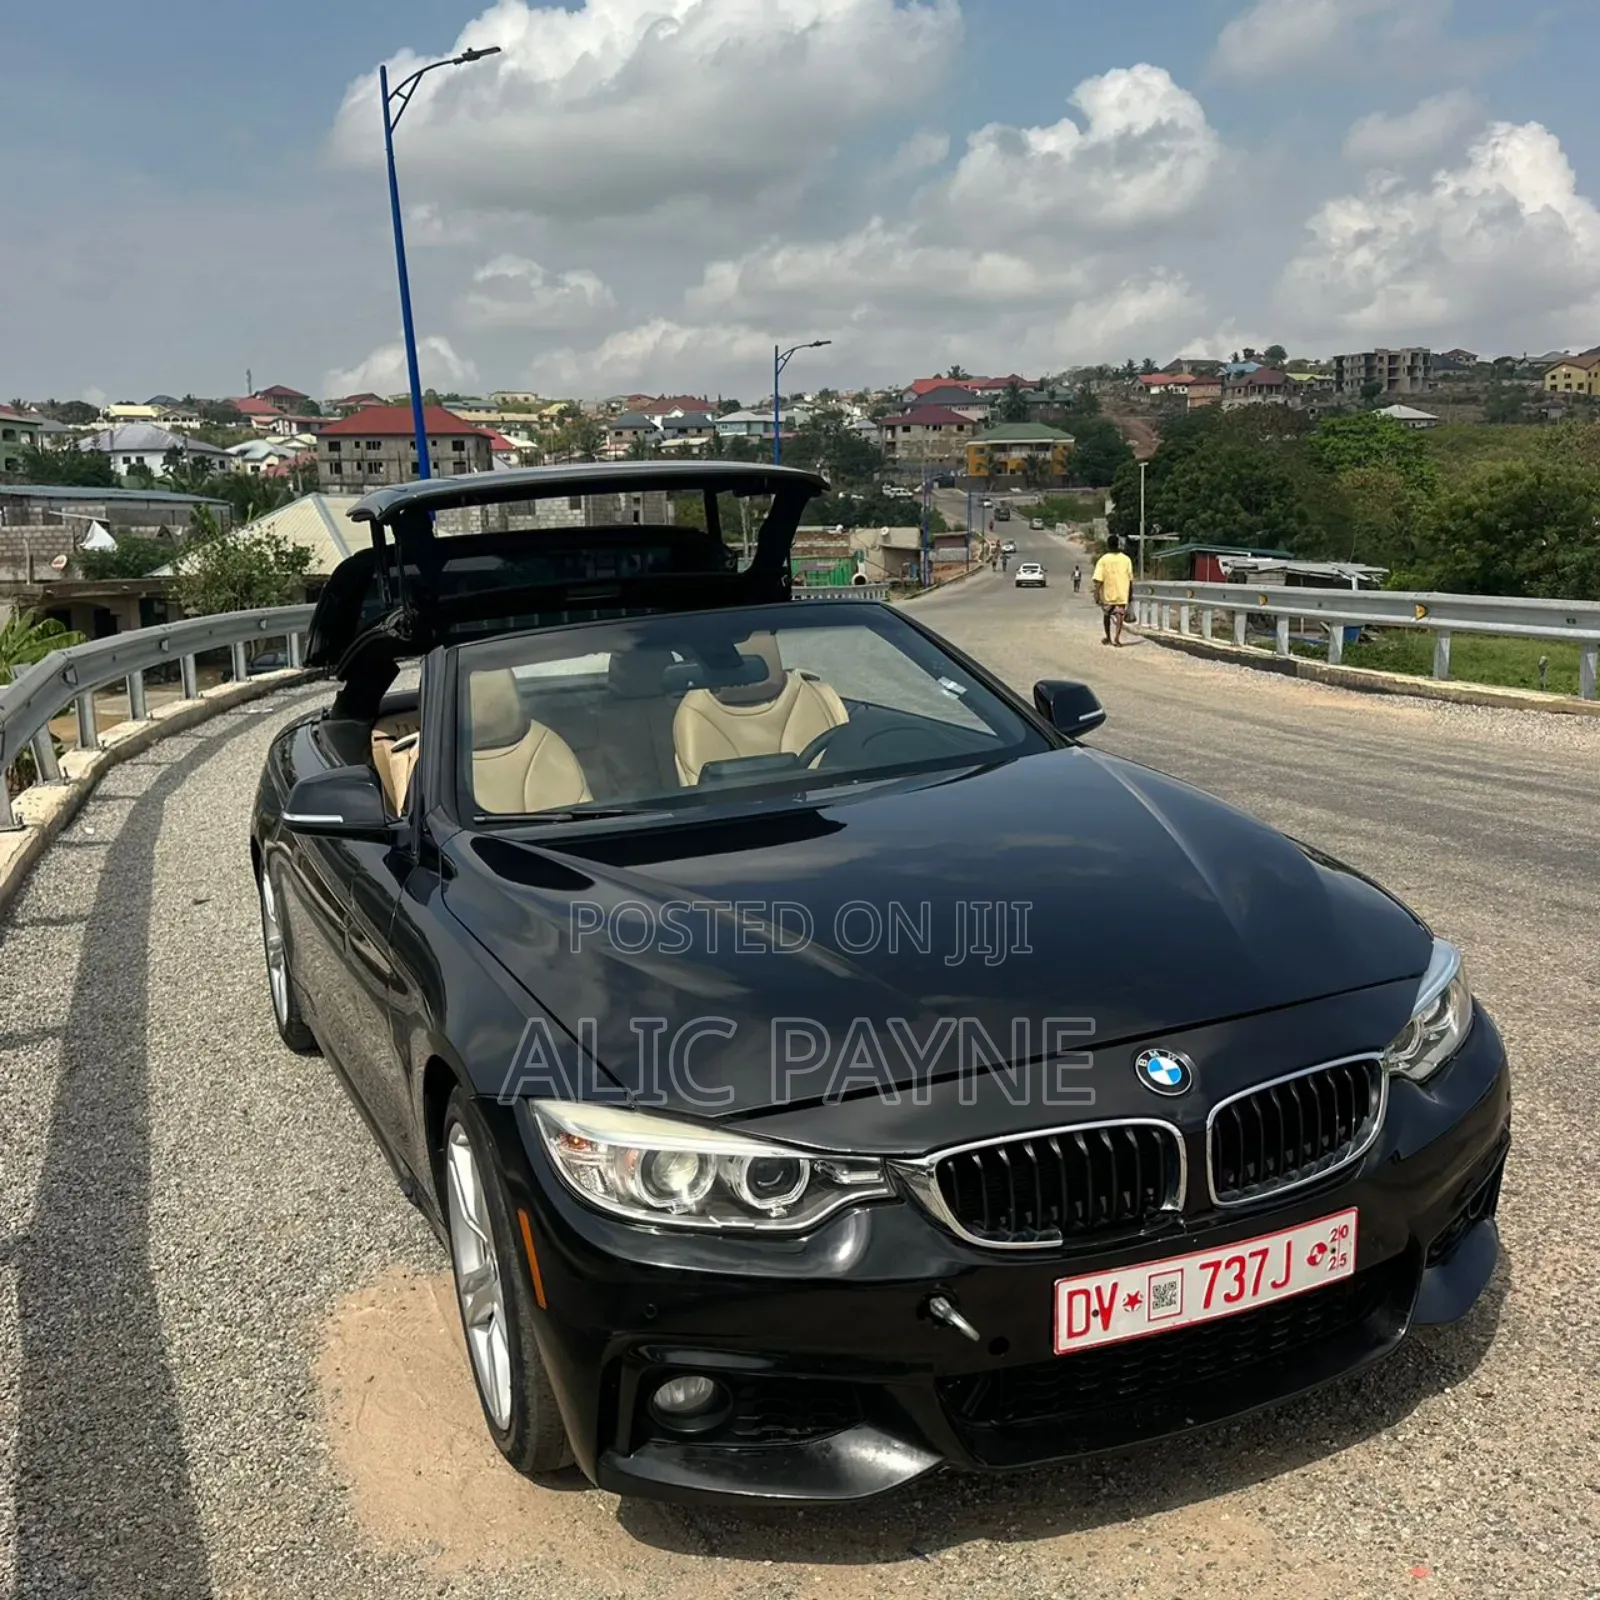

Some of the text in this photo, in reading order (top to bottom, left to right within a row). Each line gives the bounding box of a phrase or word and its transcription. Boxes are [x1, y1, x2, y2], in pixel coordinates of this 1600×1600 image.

[1138, 1049, 1179, 1067] BMW
[1329, 1224, 1349, 1242] 20
[1328, 1252, 1347, 1271] 25
[1067, 1282, 1119, 1339] DV
